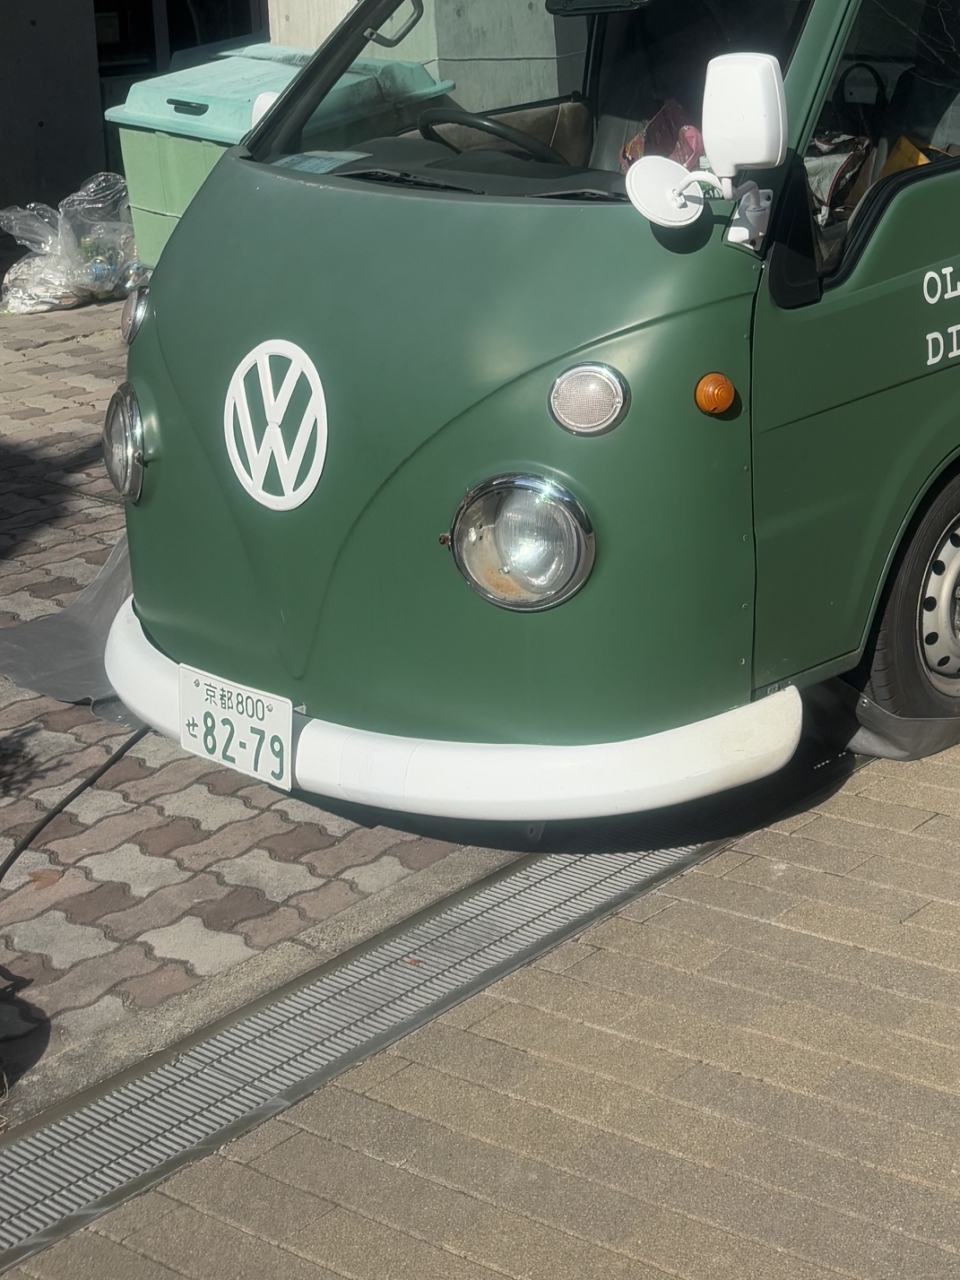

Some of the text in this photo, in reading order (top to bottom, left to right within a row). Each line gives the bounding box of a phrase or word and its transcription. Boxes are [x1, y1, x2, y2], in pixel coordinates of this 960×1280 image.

[225, 339, 327, 511] VW
[185, 710, 284, 781] せ 82-79
